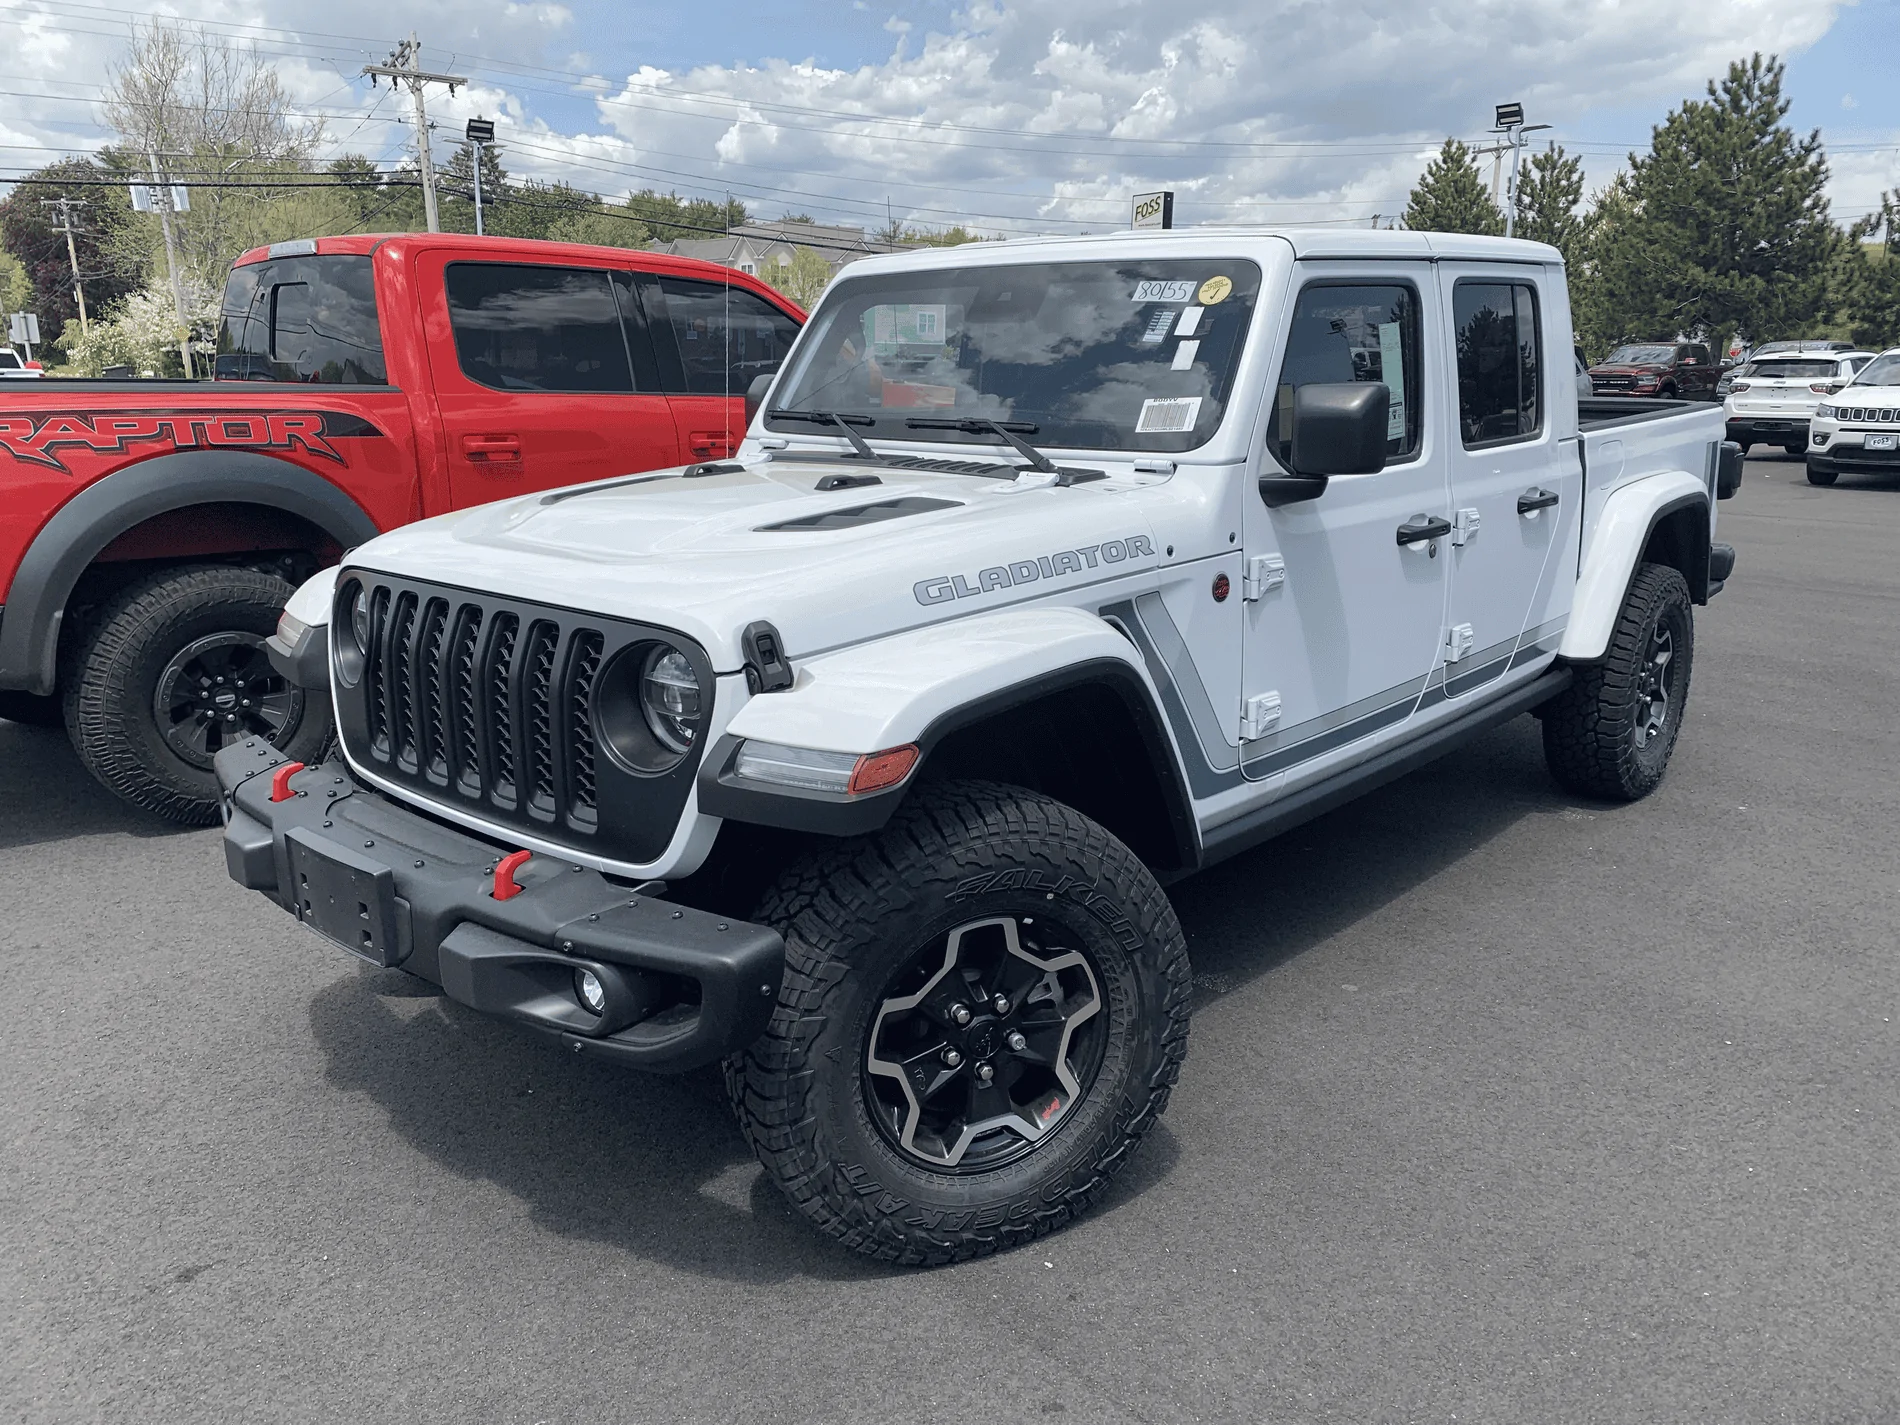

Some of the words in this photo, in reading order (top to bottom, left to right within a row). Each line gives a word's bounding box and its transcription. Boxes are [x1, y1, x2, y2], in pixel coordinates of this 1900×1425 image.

[1135, 195, 1161, 221] FOSS
[0, 412, 349, 475] RAPTOR
[1873, 437, 1889, 446] FOSS
[913, 535, 1155, 606] GLADIATOR
[945, 867, 1144, 952] FALKEN
